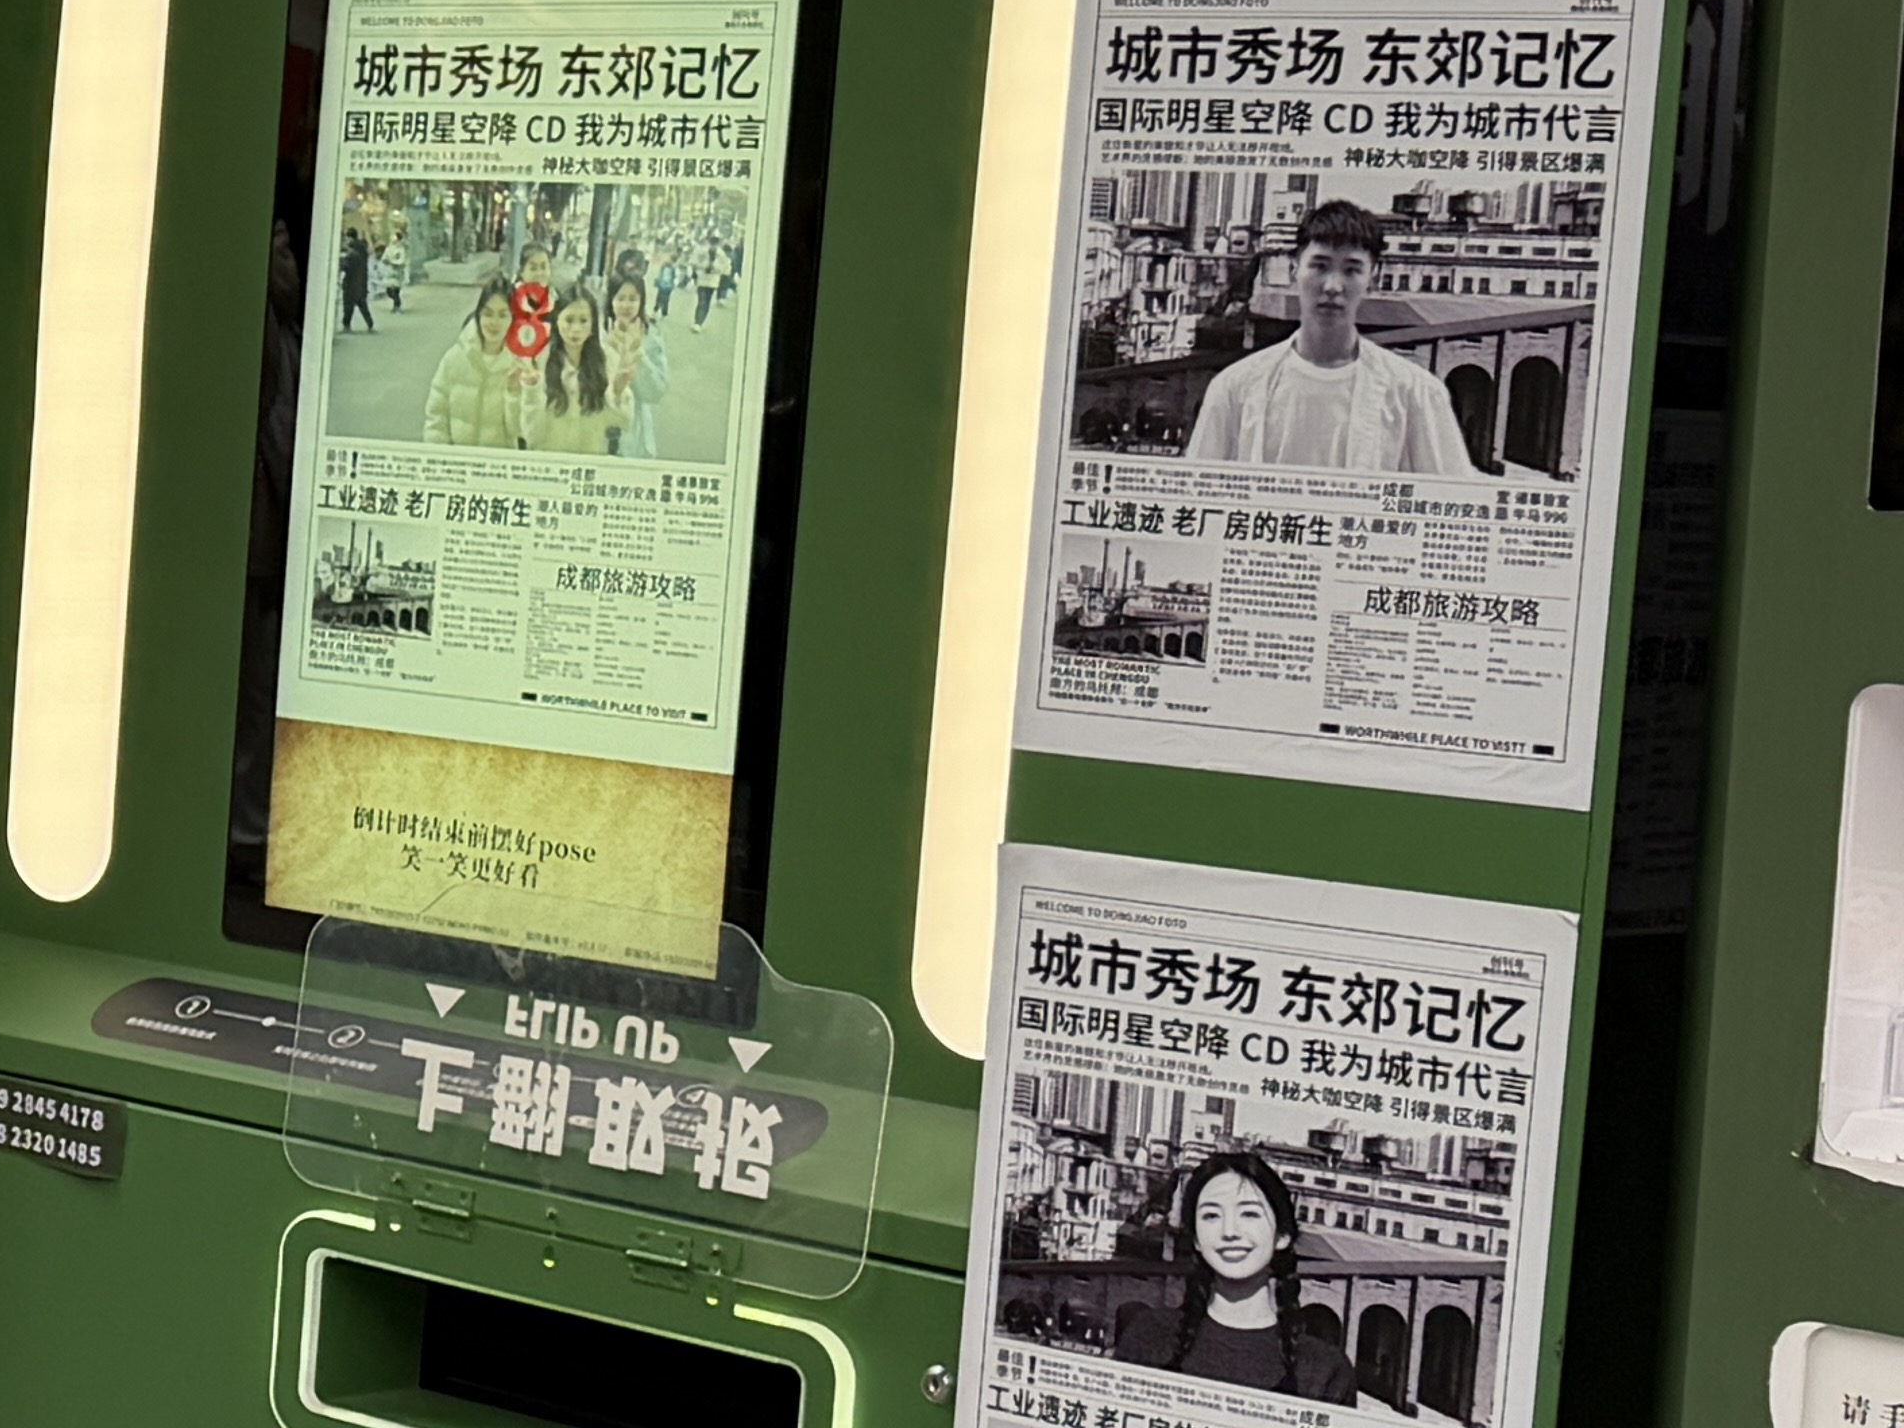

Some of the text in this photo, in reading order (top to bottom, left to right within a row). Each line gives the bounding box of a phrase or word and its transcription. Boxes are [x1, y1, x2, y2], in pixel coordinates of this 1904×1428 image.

[353, 42, 762, 100] 城市秀场 东郊记忆
[1106, 25, 1619, 91] 城市秀场 东郊记忆
[343, 110, 766, 150] 国际明星空降 CD 我为城市代言
[1094, 97, 1623, 144] 国际明星空降 CD 我为城市代言
[505, 280, 552, 358] 8
[317, 483, 532, 529] 工业遗迹 老厂房的新生
[1060, 499, 1332, 547] 工业遗迹 老厂房的新生
[556, 563, 697, 602] 成都旅游攻略
[1363, 585, 1540, 628] 成都旅游攻略
[353, 805, 597, 864] 倒计时结束前摆好pose
[399, 843, 539, 889] 笑一笑更好看
[1027, 928, 1528, 1053] 城市秀场 东郊记忆
[1017, 995, 1533, 1106] 国际明星空降 CD 我为城市代言
[59, 1102, 104, 1132] 4178
[11, 1126, 54, 1155] 2320
[58, 1138, 102, 1167] 1485
